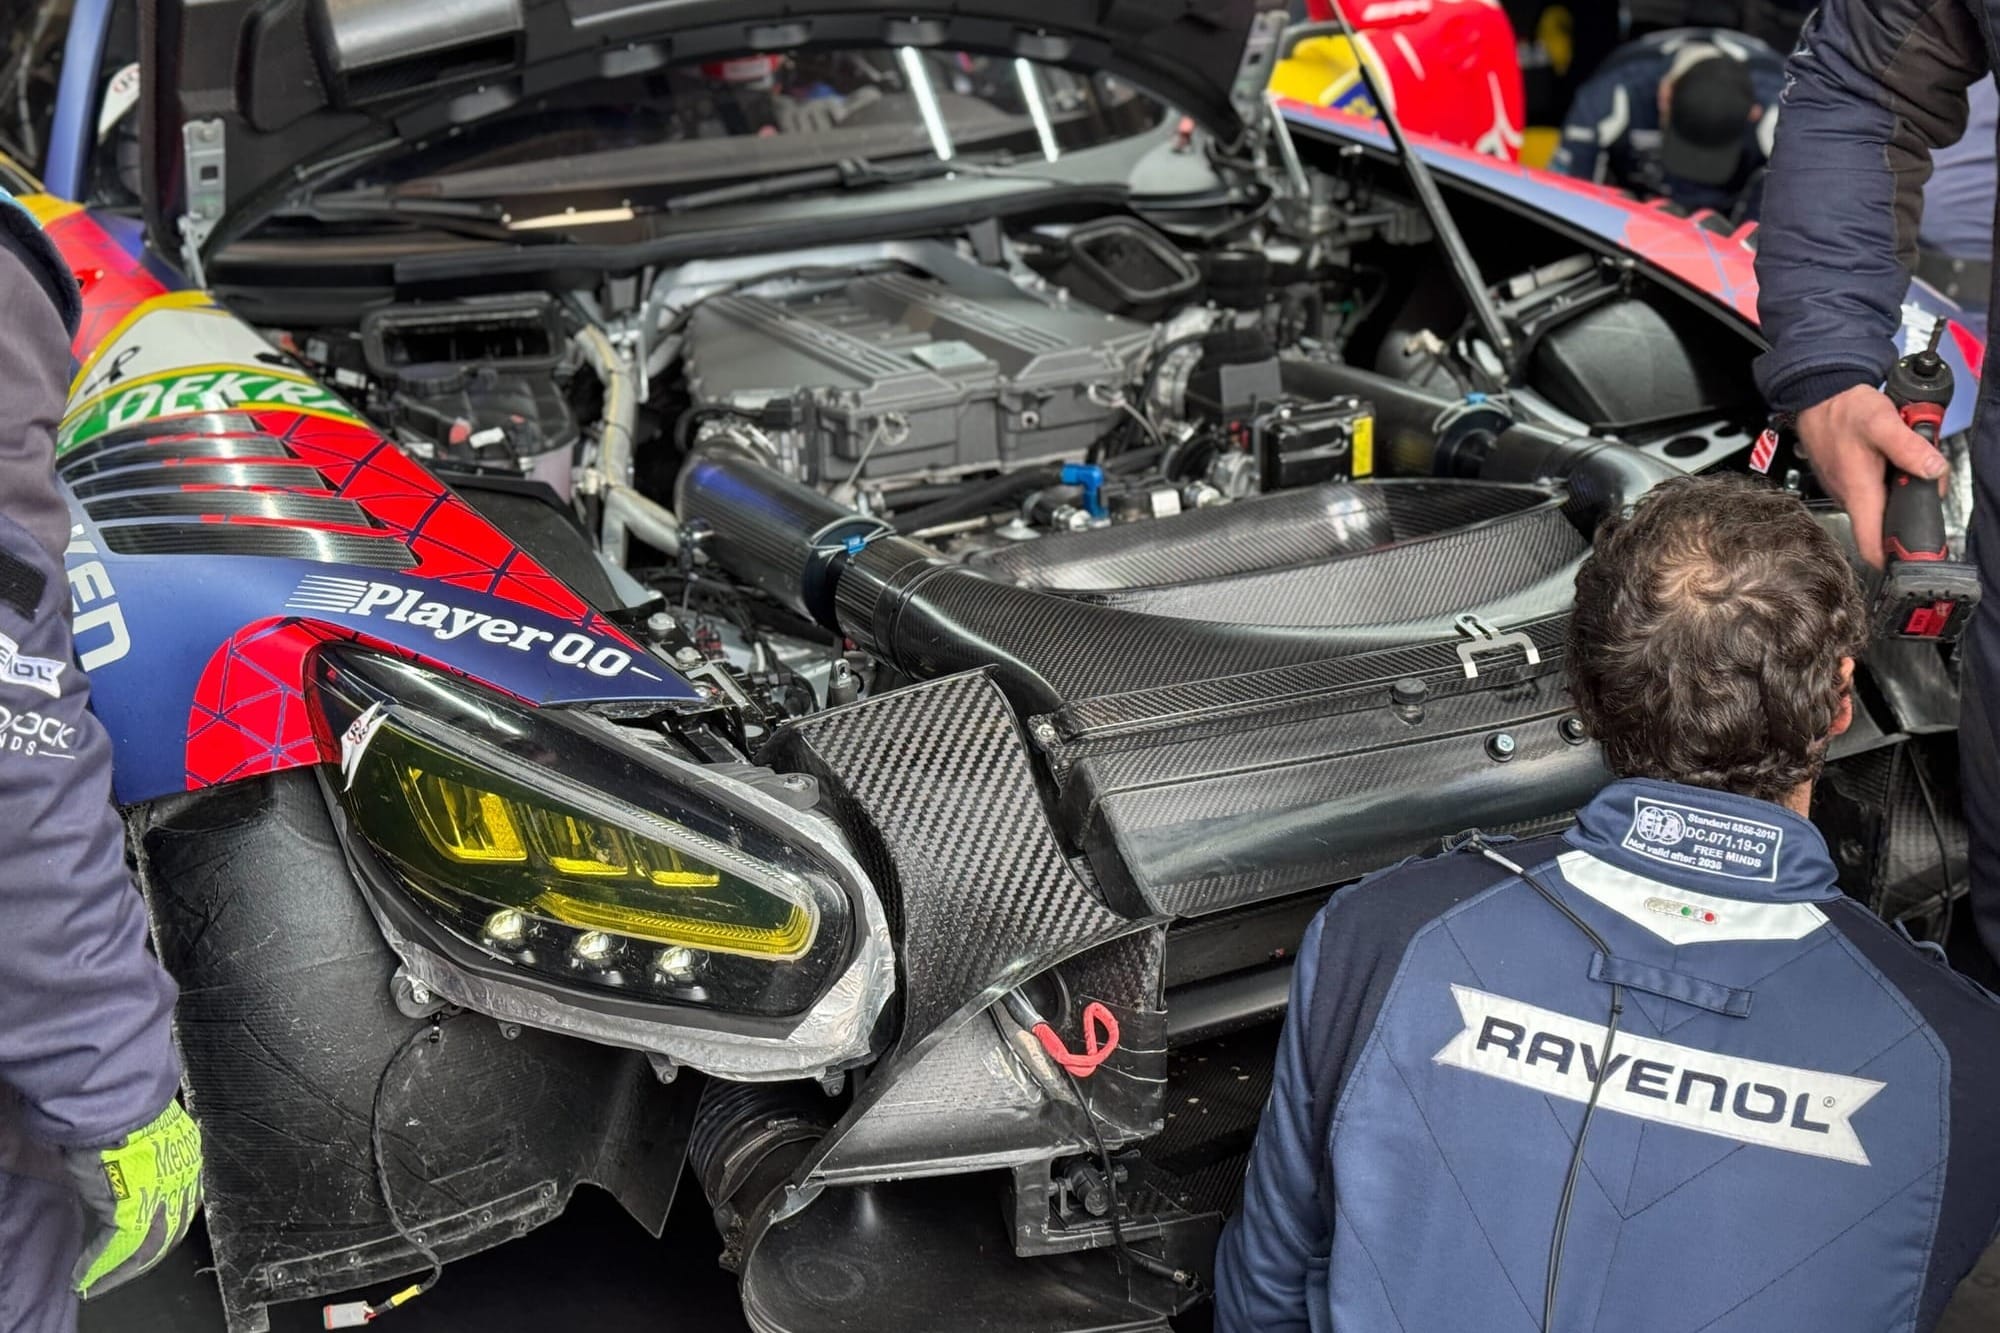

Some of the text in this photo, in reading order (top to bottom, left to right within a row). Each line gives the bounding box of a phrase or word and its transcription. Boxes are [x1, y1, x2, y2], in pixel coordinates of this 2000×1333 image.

[349, 582, 632, 677] Player 0.0
[1687, 813, 1731, 831] Standard
[1627, 838, 1645, 851] Not
[1646, 845, 1671, 859] valid
[1670, 851, 1697, 866] after:
[1693, 844, 1762, 868] FREE MINDS
